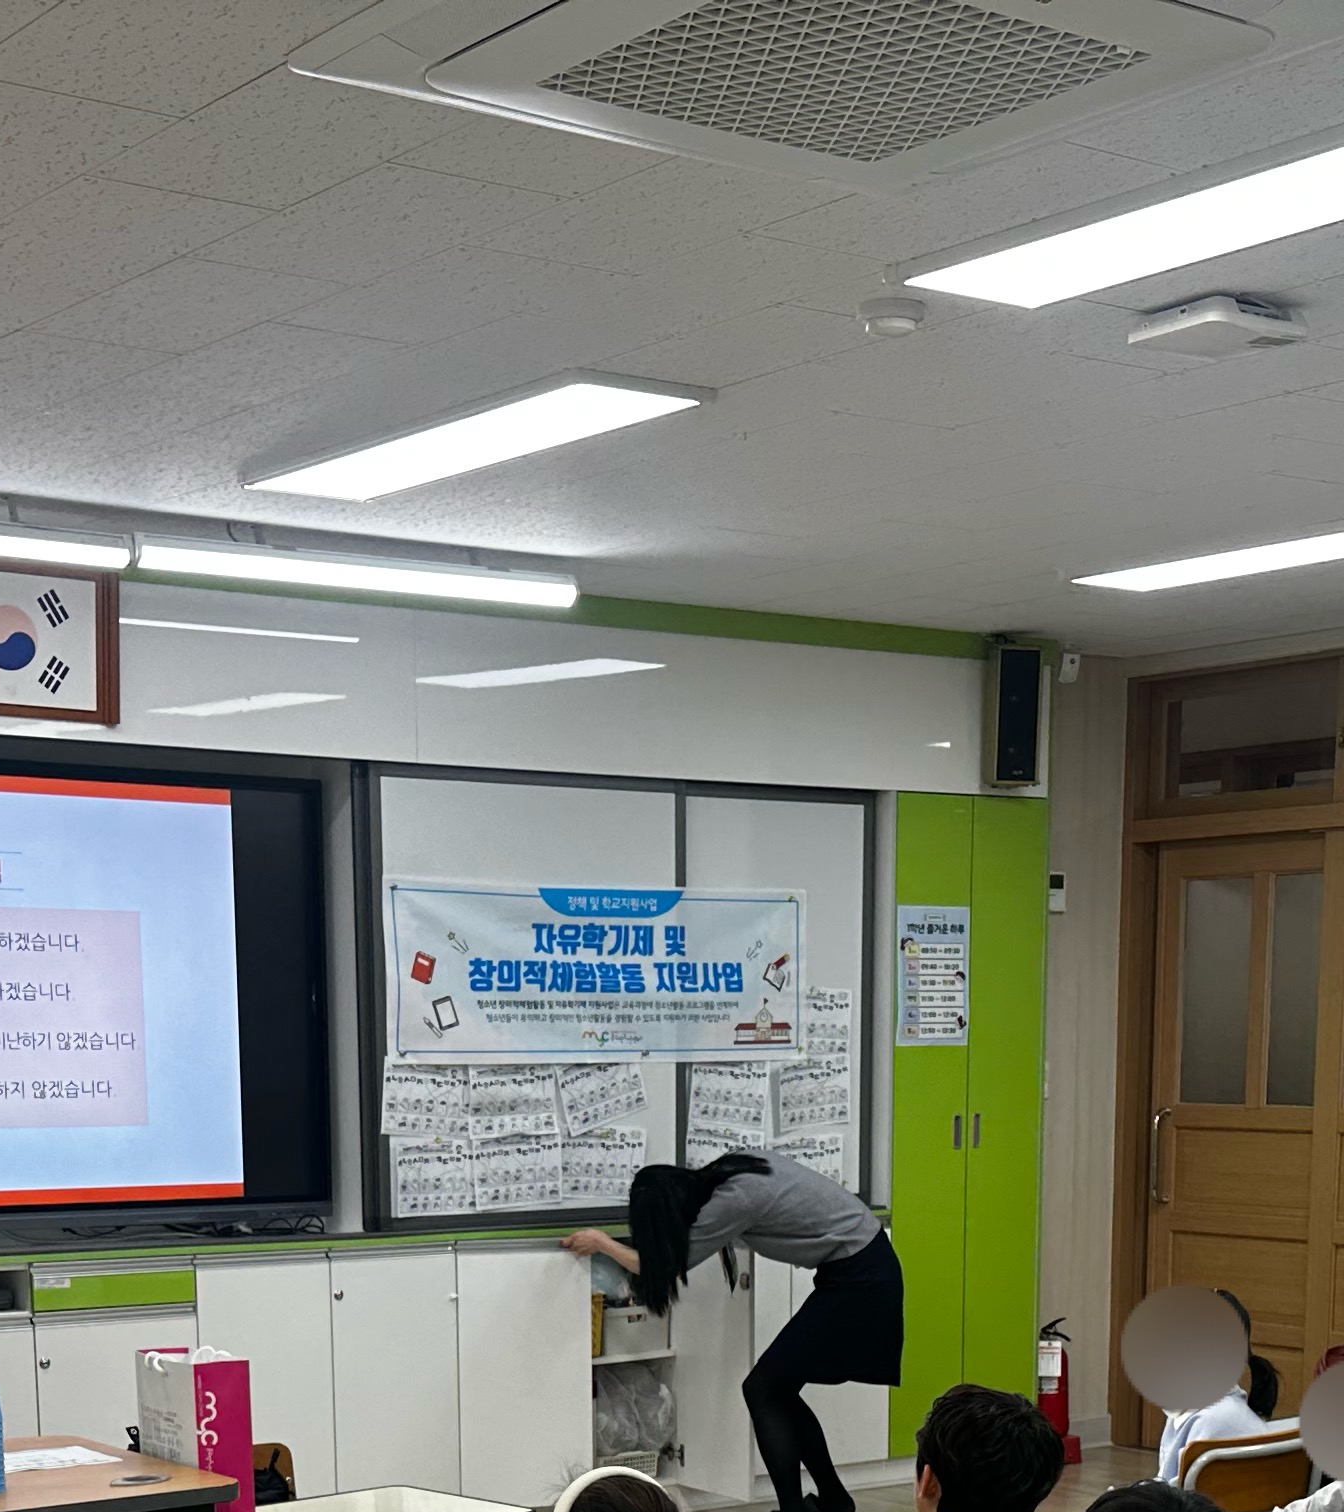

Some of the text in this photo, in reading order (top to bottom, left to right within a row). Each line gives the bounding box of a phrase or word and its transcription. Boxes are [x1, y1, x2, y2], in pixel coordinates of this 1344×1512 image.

[567, 895, 657, 912] 정책 및 학교지원사업
[531, 922, 686, 957] 자유학기제 및
[468, 957, 744, 994] 창의적체험활동 지원사업
